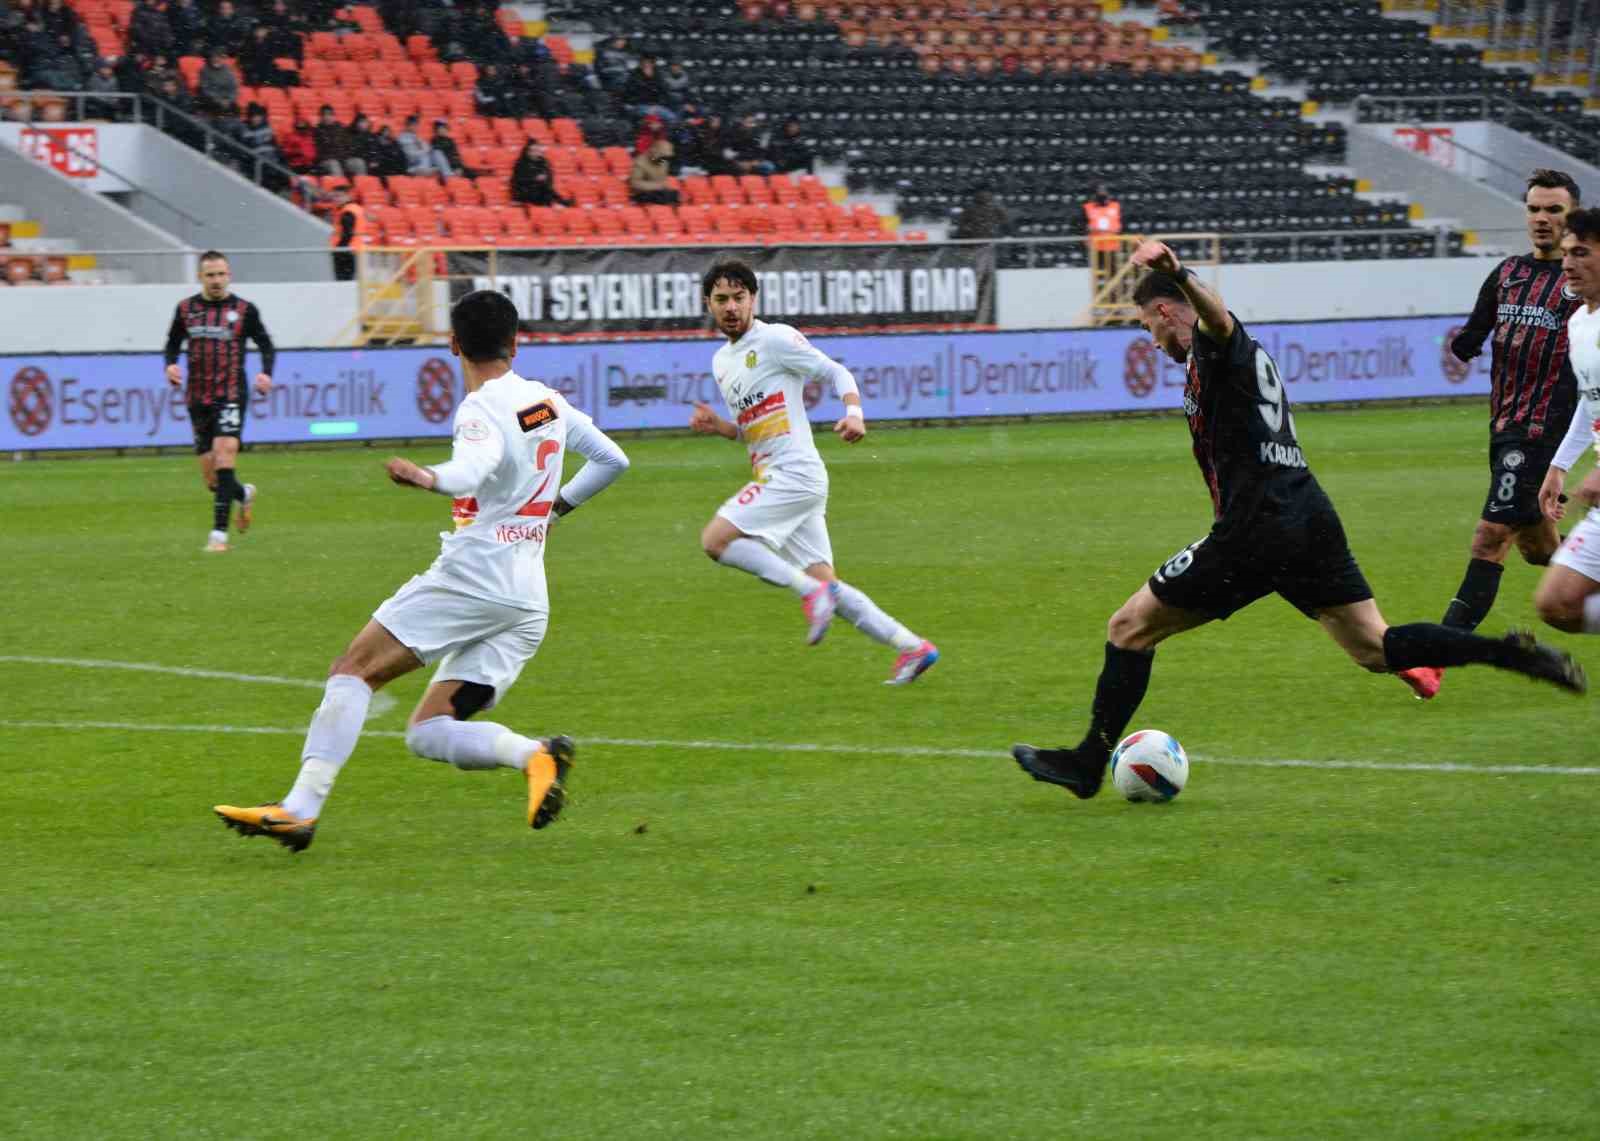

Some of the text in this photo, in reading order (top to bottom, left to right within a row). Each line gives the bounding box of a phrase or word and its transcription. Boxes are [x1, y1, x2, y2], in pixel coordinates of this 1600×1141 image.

[911, 267, 977, 312] AMA
[1521, 305, 1545, 317] STAR
[960, 349, 1099, 395] Denizcilik
[1286, 336, 1415, 382] Denizcilik
[61, 379, 188, 436] Esenye
[251, 369, 388, 418] enizcilik
[515, 439, 560, 517] 2
[1498, 472, 1517, 501] 8
